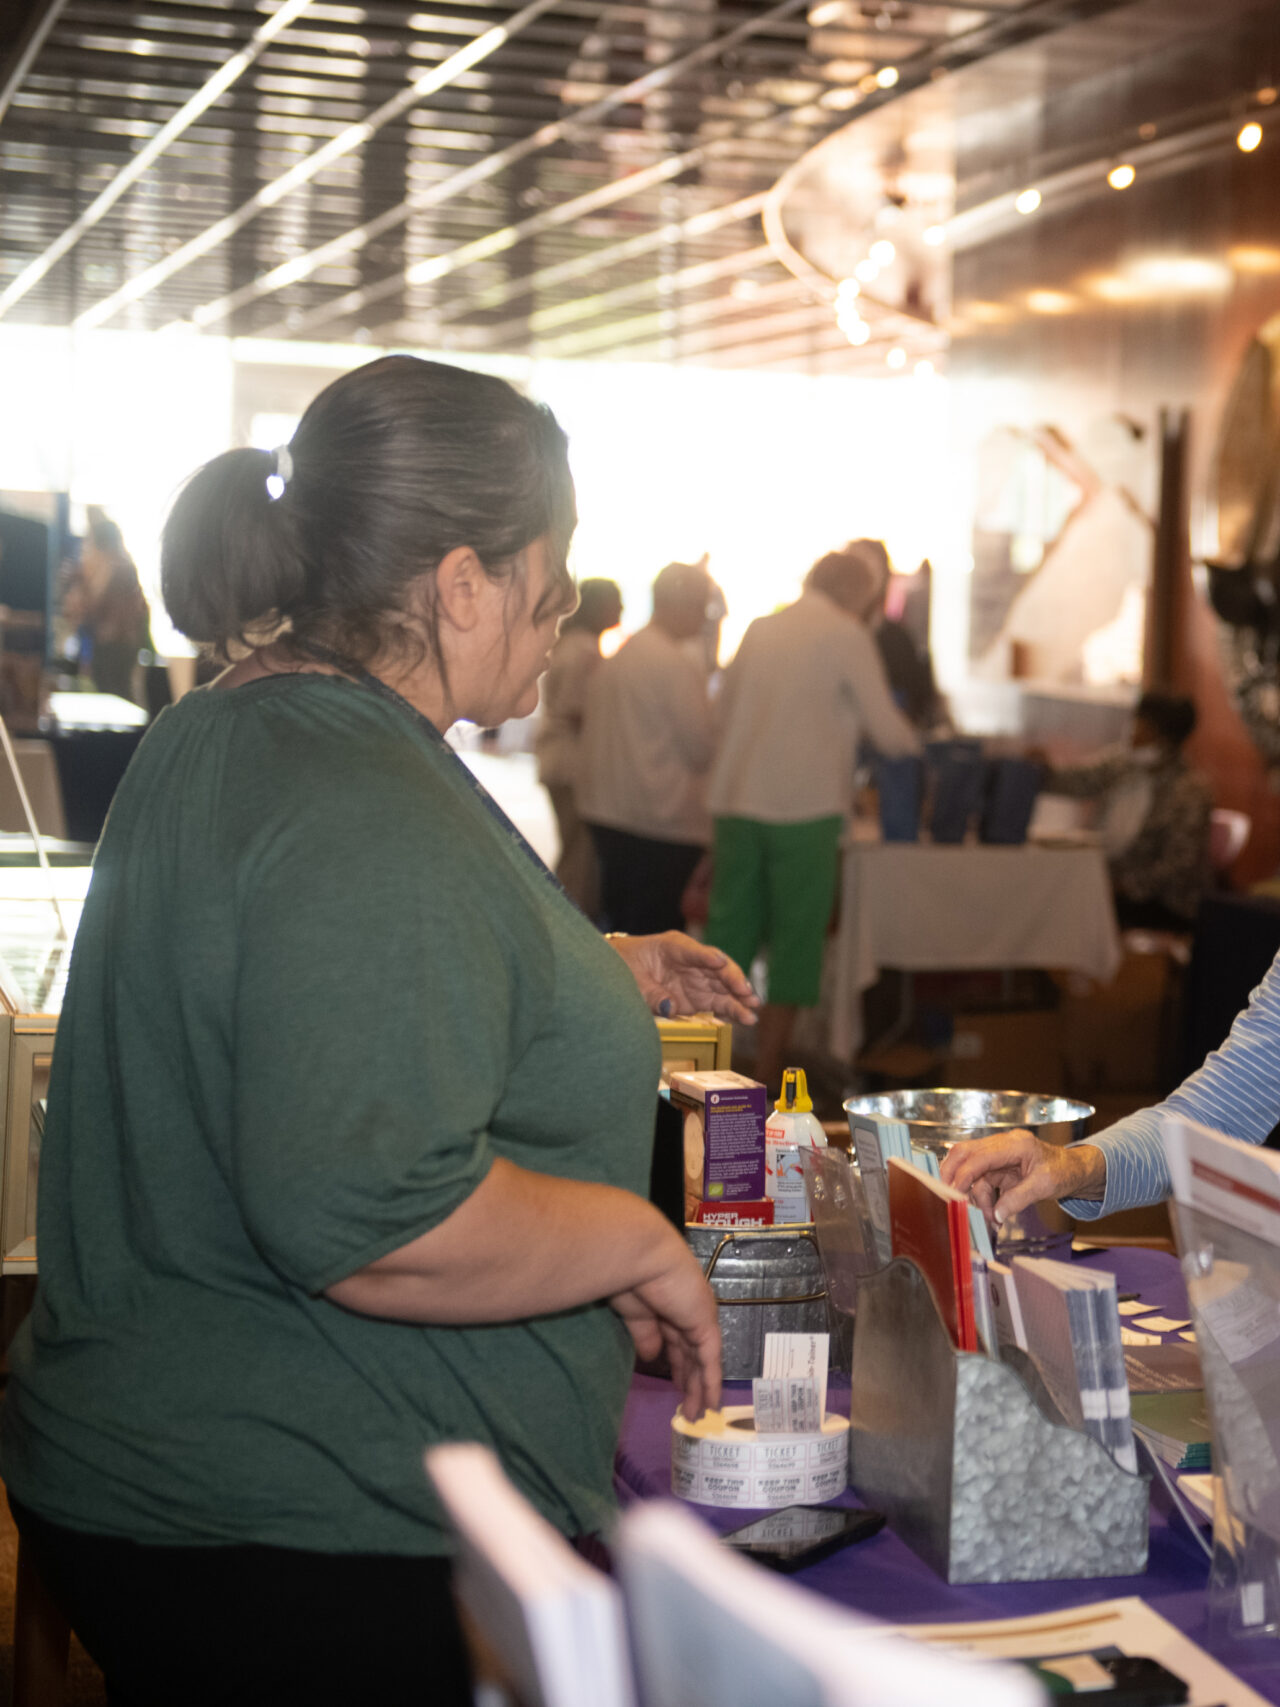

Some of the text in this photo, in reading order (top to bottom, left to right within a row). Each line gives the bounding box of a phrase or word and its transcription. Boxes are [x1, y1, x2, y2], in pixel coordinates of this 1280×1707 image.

[703, 1211, 739, 1221] HYPER
[703, 1217, 763, 1227] TOUGH
[817, 1439, 839, 1454] TICKET
[710, 1446, 740, 1458] TICKET
[765, 1446, 796, 1458] TICKET
[705, 1476, 744, 1487] KEEP THIS
[783, 1477, 800, 1486] THIS
[811, 1473, 828, 1482] KEEP
[708, 1483, 740, 1492] COUPON
[815, 1477, 838, 1489] COUPON
[762, 1485, 796, 1493] COUPON
